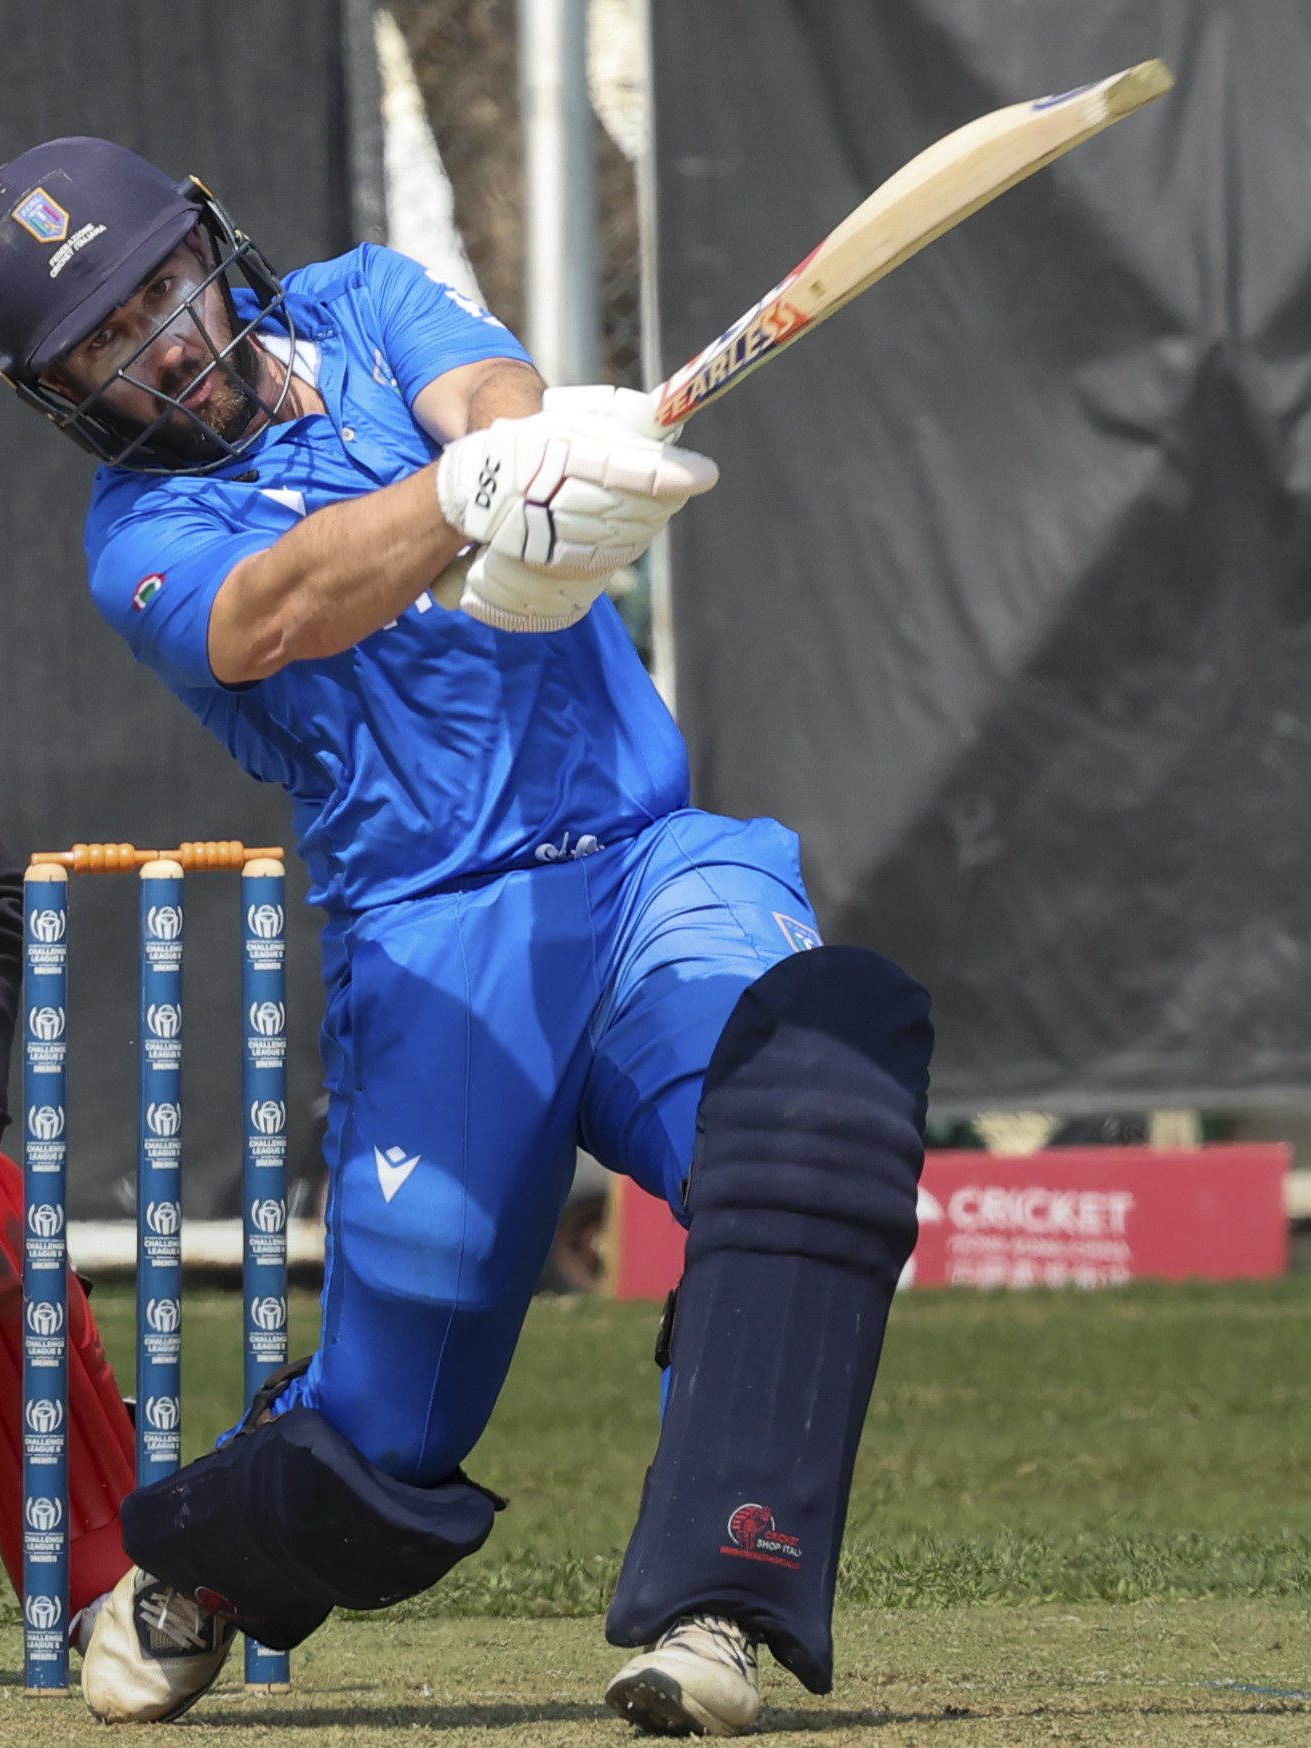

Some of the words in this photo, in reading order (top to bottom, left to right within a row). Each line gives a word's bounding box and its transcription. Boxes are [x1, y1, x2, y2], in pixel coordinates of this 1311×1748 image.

[655, 301, 797, 426] FEARLESS
[475, 456, 500, 508] DSC
[948, 1187, 1133, 1236] CRICKET
[756, 1539, 781, 1551] SHOP
[782, 1545, 803, 1558] ITALY
